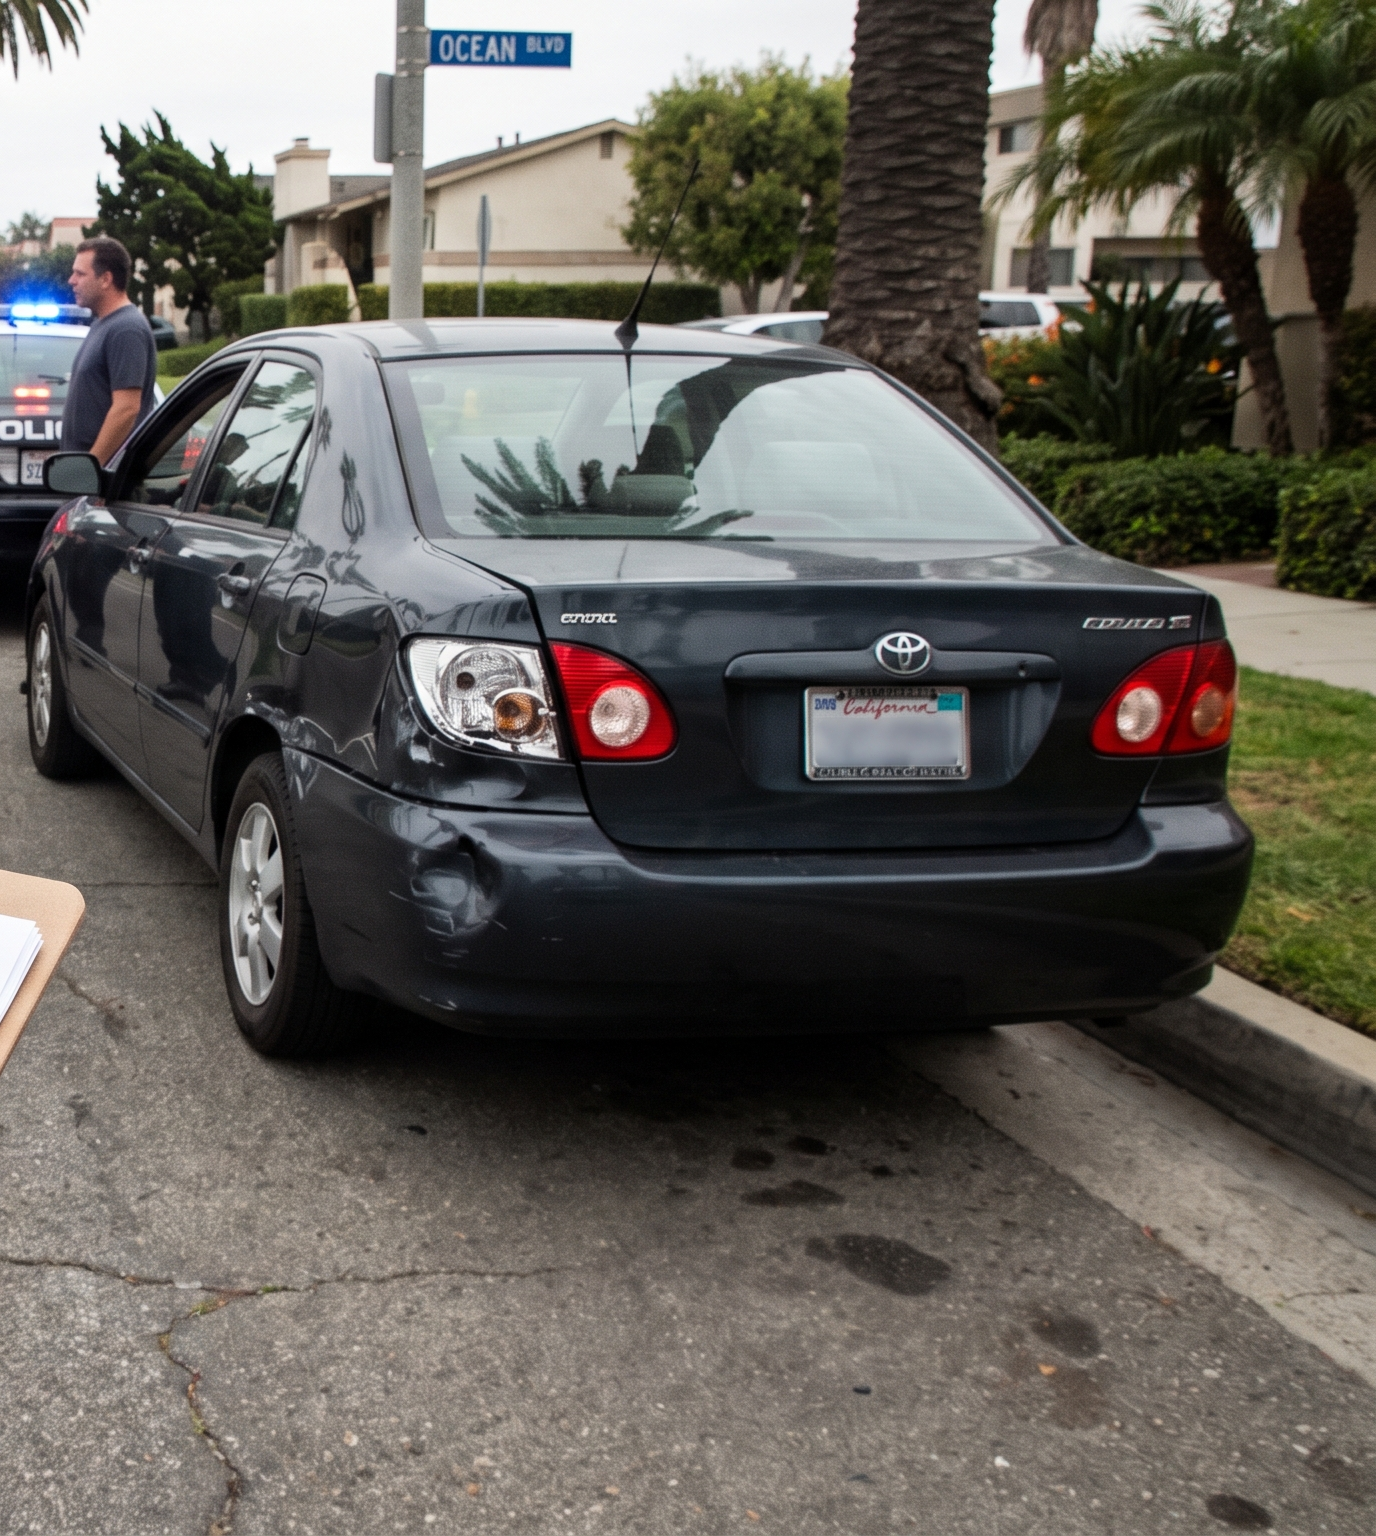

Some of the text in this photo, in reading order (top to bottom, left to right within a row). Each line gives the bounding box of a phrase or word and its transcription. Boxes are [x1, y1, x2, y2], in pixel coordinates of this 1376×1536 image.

[438, 34, 565, 63] OCEAN BLVD
[843, 697, 937, 719] California
